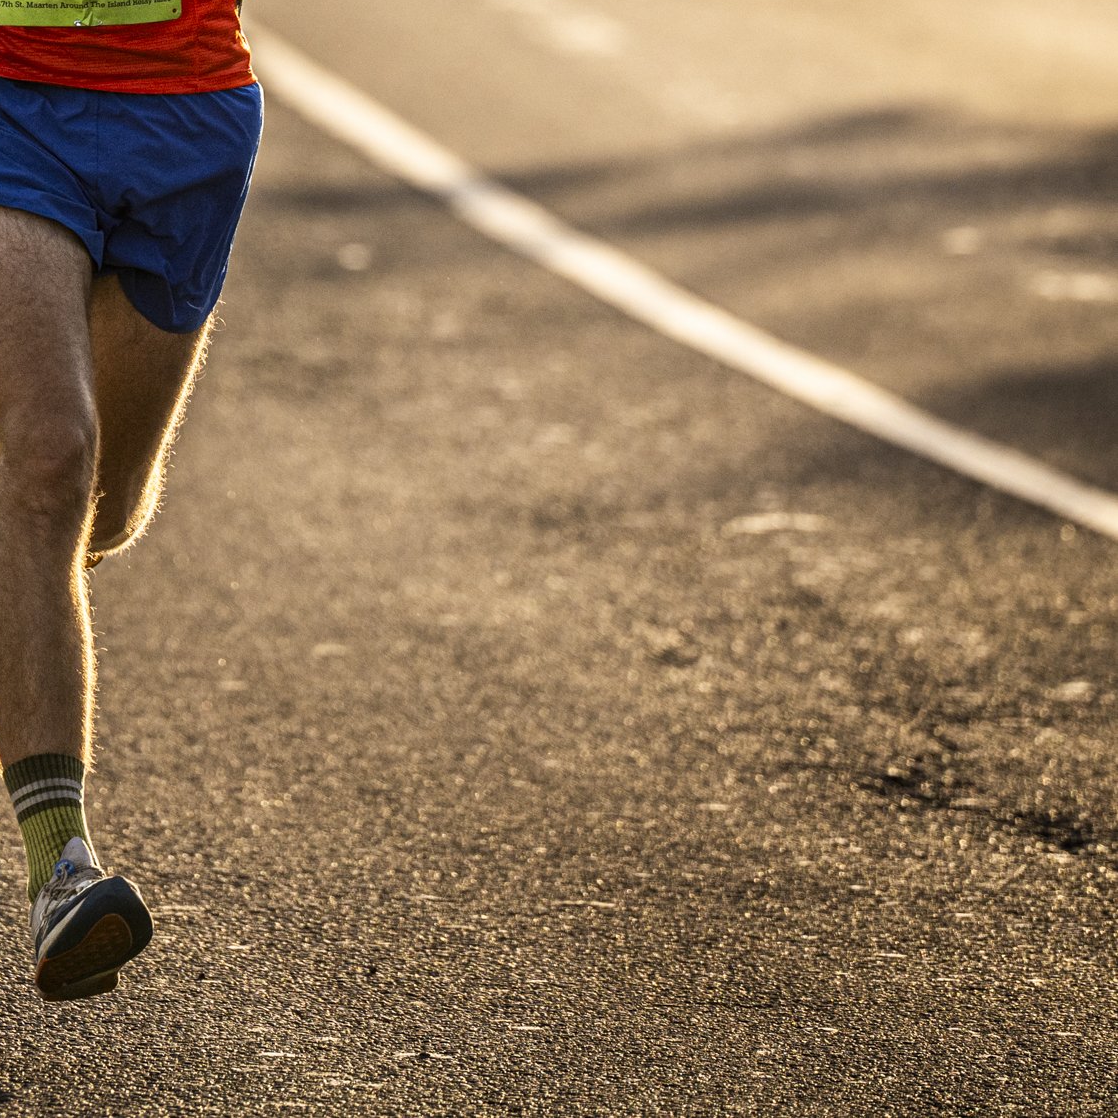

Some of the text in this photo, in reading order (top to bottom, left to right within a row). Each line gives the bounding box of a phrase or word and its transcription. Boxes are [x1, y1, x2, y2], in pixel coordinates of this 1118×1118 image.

[26, 1, 58, 9] Maarten
[60, 1, 89, 9] Around
[90, 0, 106, 9] The
[108, 0, 131, 8] Island
